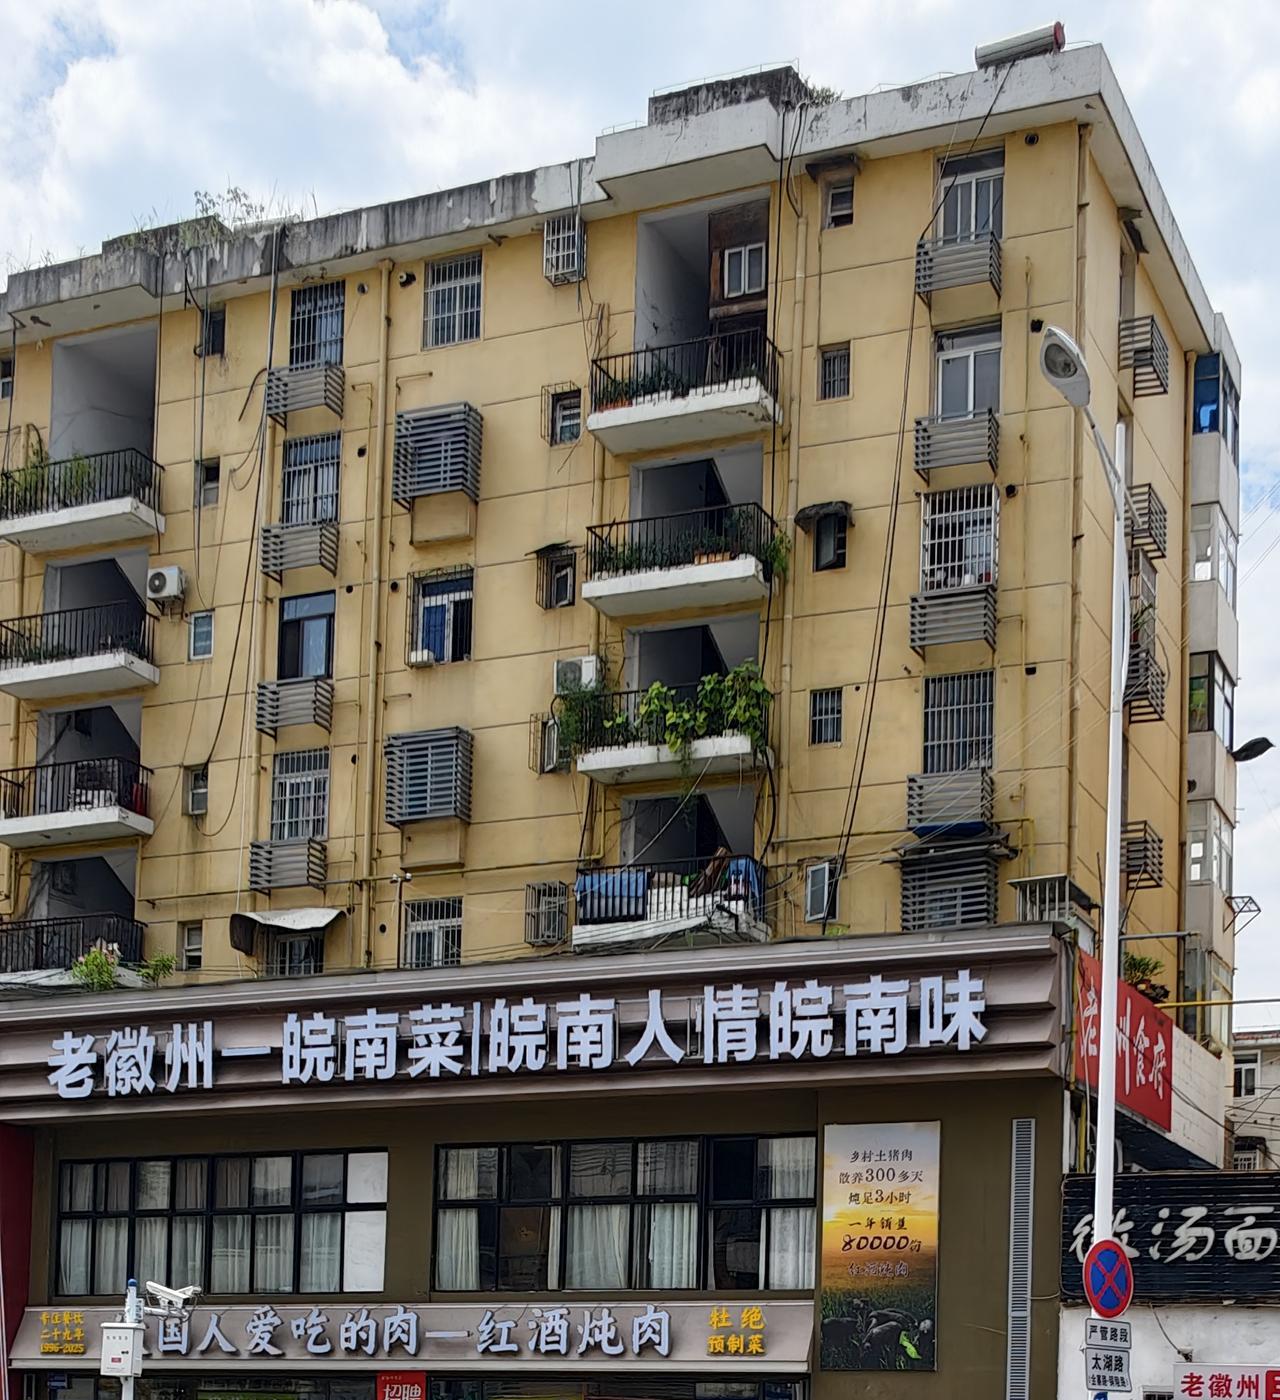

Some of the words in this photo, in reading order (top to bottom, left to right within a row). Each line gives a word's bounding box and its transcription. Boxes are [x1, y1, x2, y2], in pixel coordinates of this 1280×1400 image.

[1081, 976, 1167, 1100] 老州食府
[850, 1149, 912, 1163] 乡村土猪肉
[839, 1167, 923, 1184] 散养300多天
[848, 1217, 908, 1230] 一年销量
[842, 1234, 922, 1252] 80000份
[710, 1305, 767, 1329] 杜绝
[40, 1328, 84, 1341] 二十九年
[1088, 1325, 1128, 1343] 严管路段
[707, 1334, 765, 1354] 预制菜
[1092, 1353, 1123, 1372] 太湖路
[1181, 1373, 1259, 1399] 老徽州
